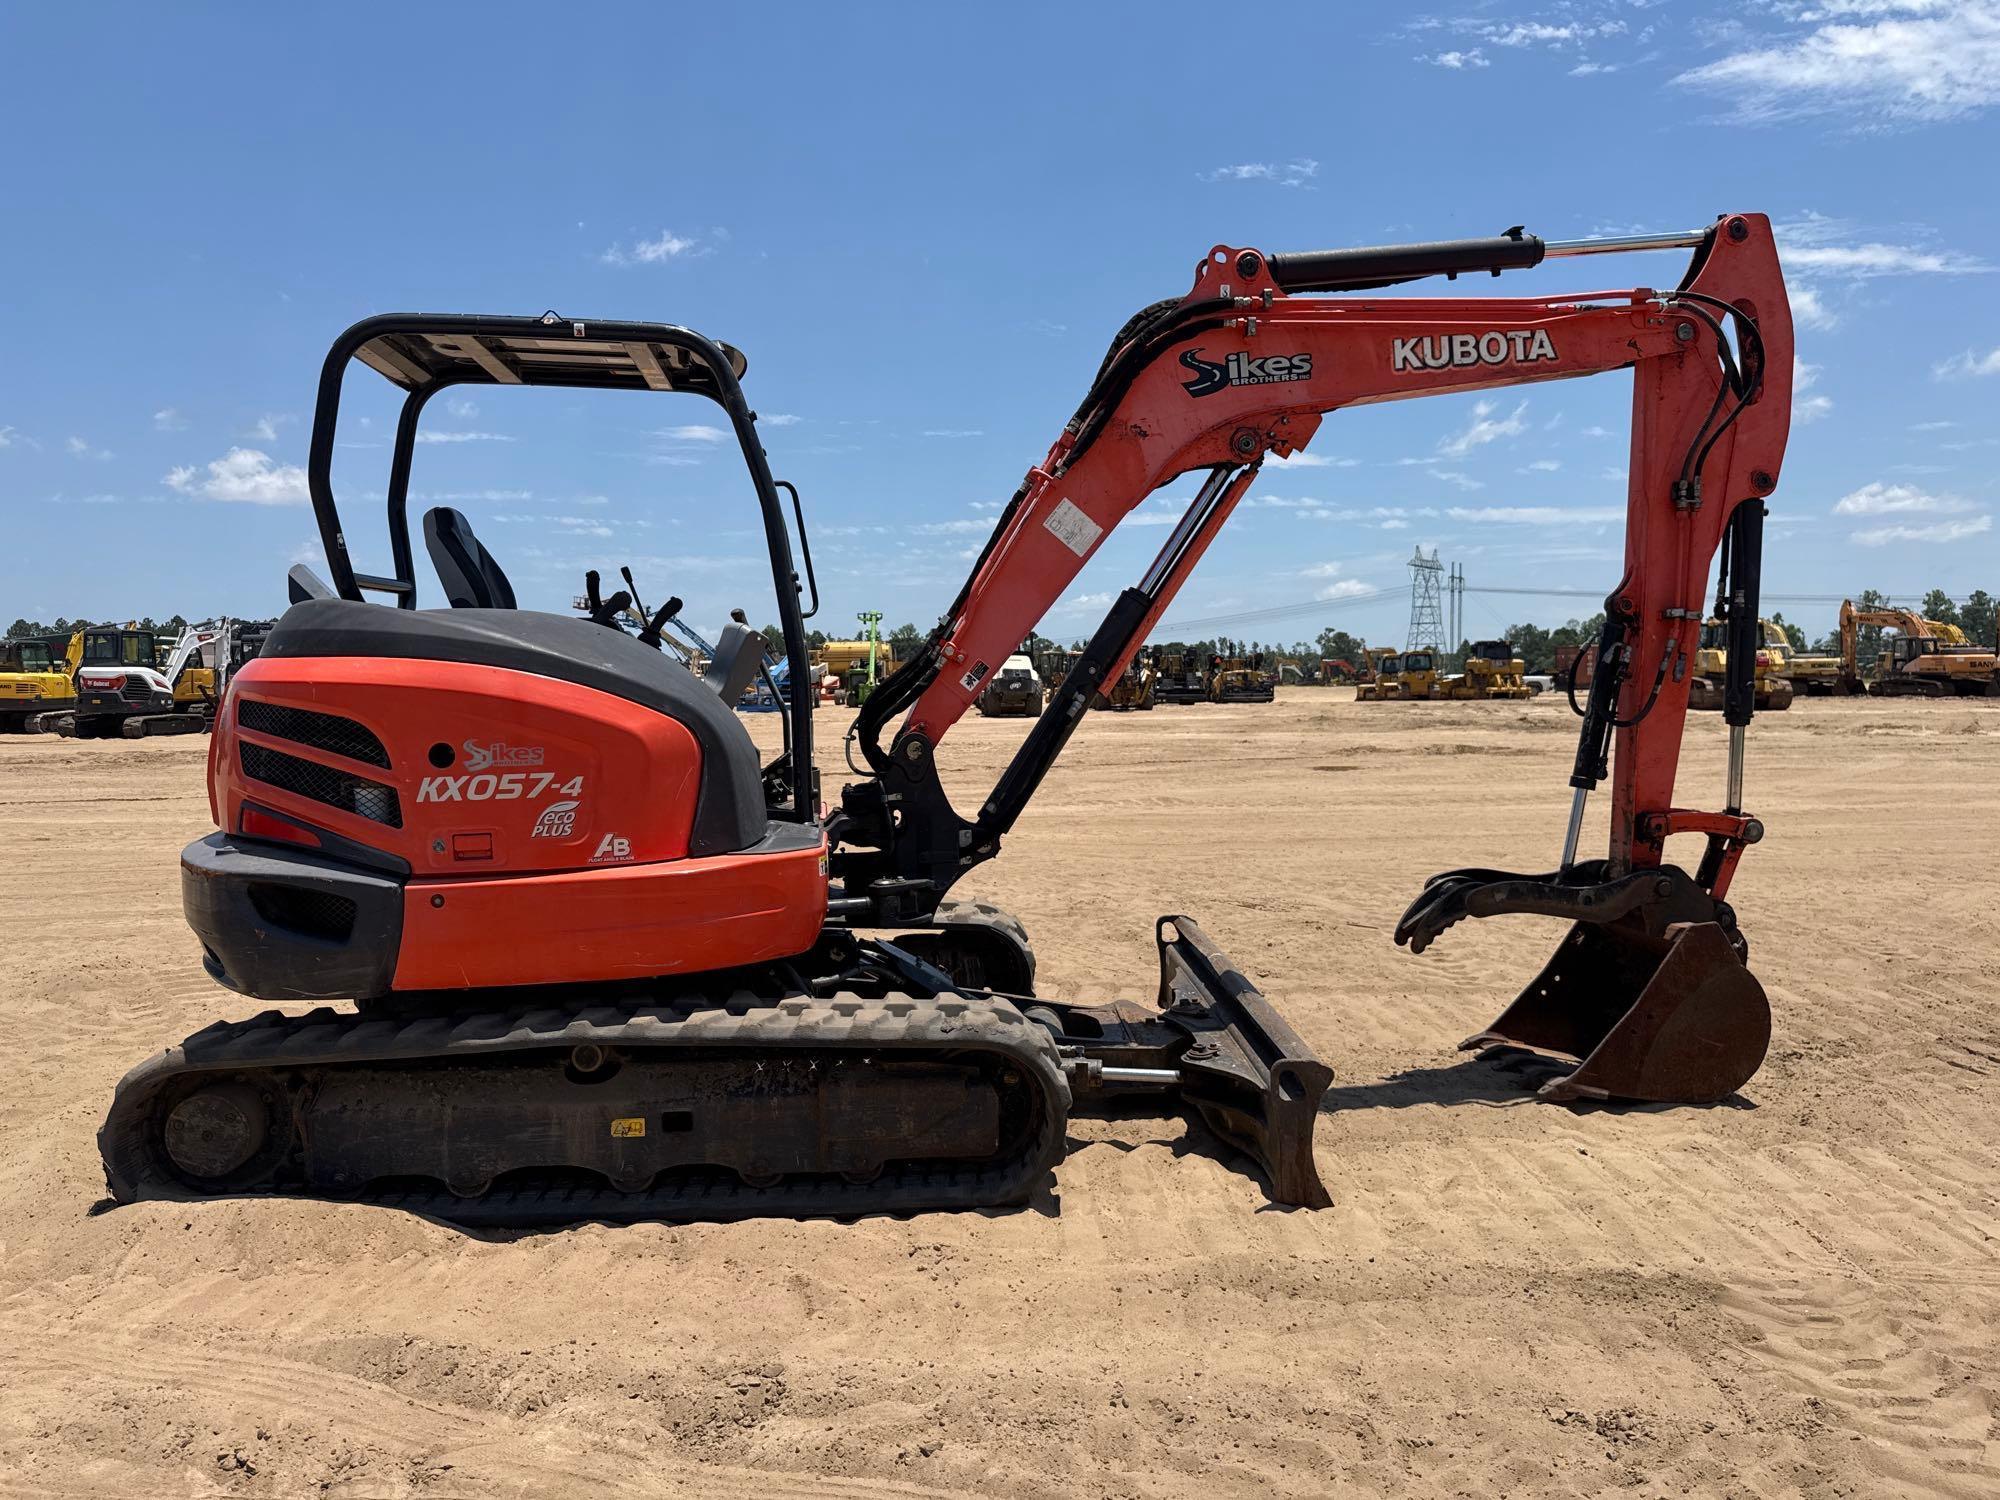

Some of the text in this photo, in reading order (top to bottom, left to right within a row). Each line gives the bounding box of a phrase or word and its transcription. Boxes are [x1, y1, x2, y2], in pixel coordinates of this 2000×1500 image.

[1393, 329, 1557, 370] KUBOTA
[1179, 348, 1312, 398] Sikes
[1231, 373, 1298, 386] BROTHERS
[416, 772, 584, 802] KX057-4
[543, 811, 576, 825] eco
[531, 824, 573, 838] PLUS
